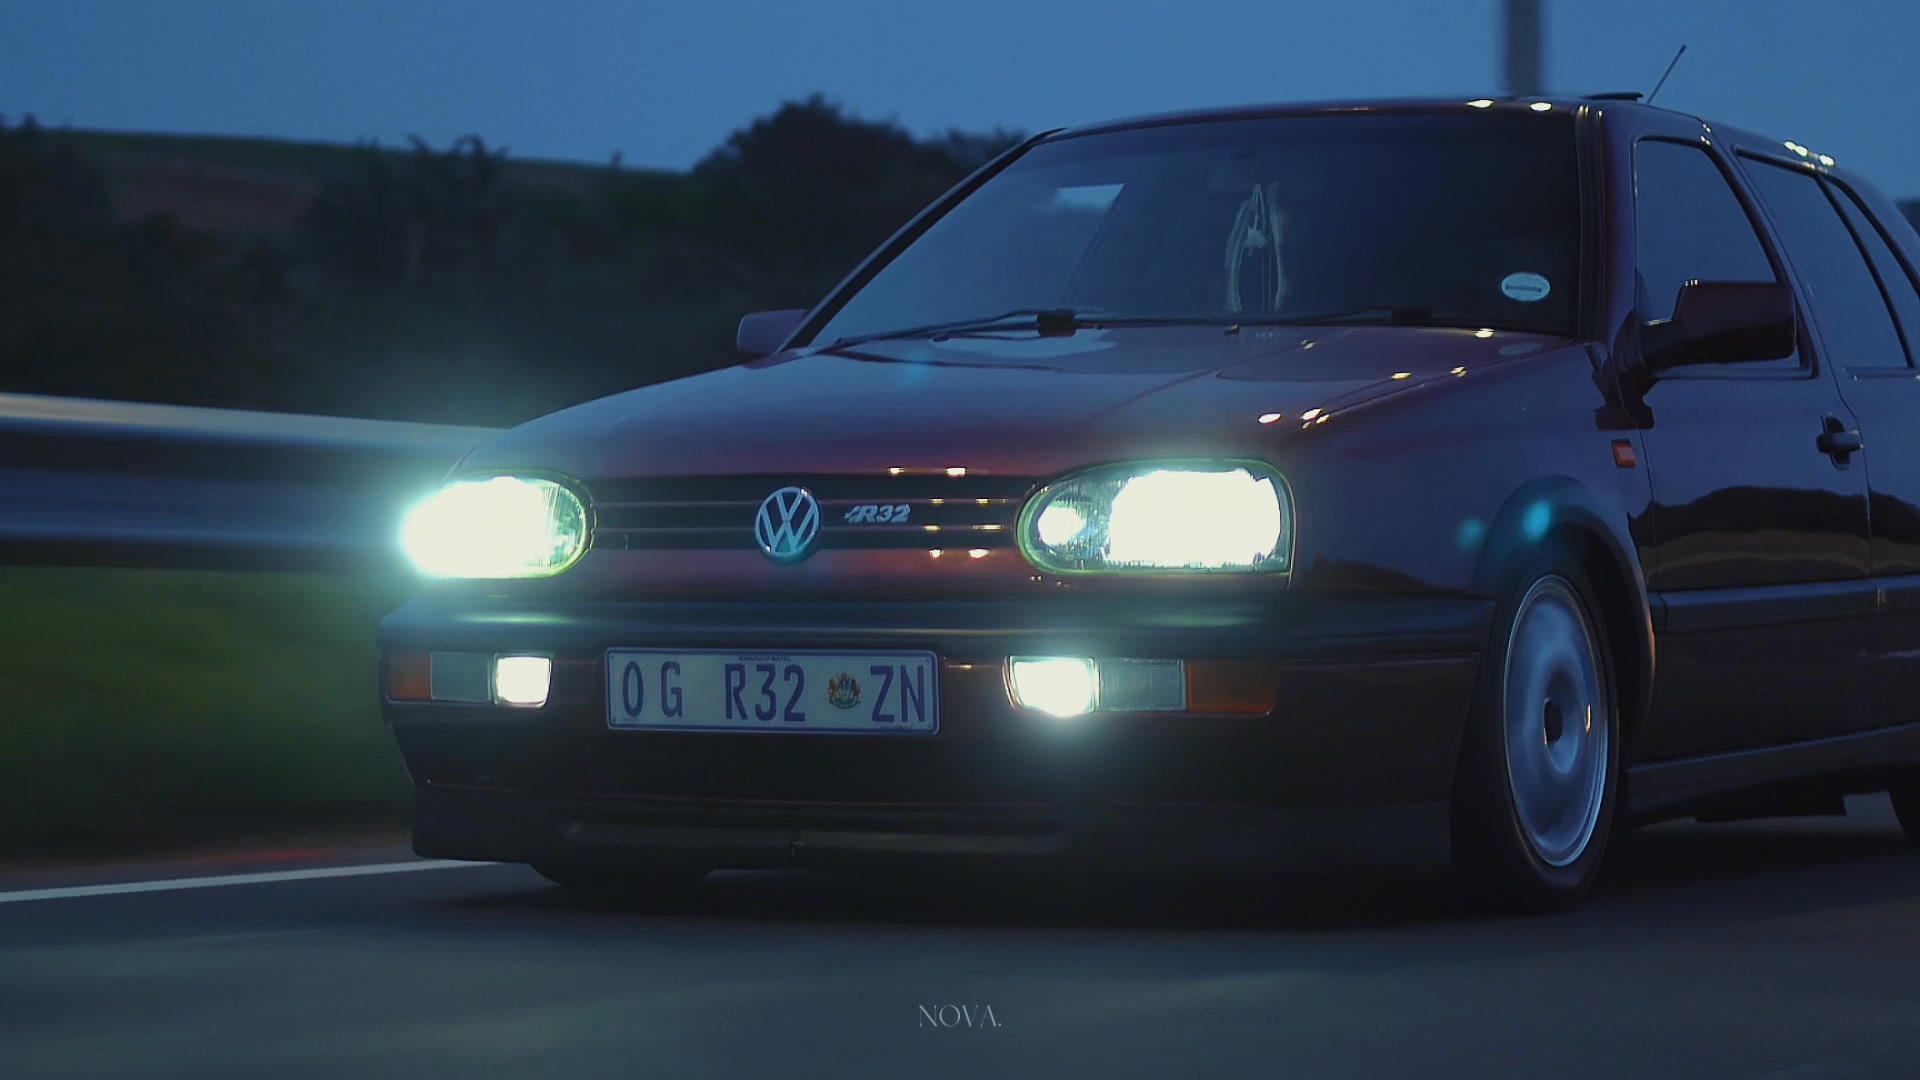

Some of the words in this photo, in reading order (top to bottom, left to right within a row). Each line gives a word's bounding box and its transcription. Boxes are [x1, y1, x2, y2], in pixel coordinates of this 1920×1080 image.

[853, 504, 911, 523] R32
[724, 662, 807, 722] R32
[869, 664, 926, 723] ZN
